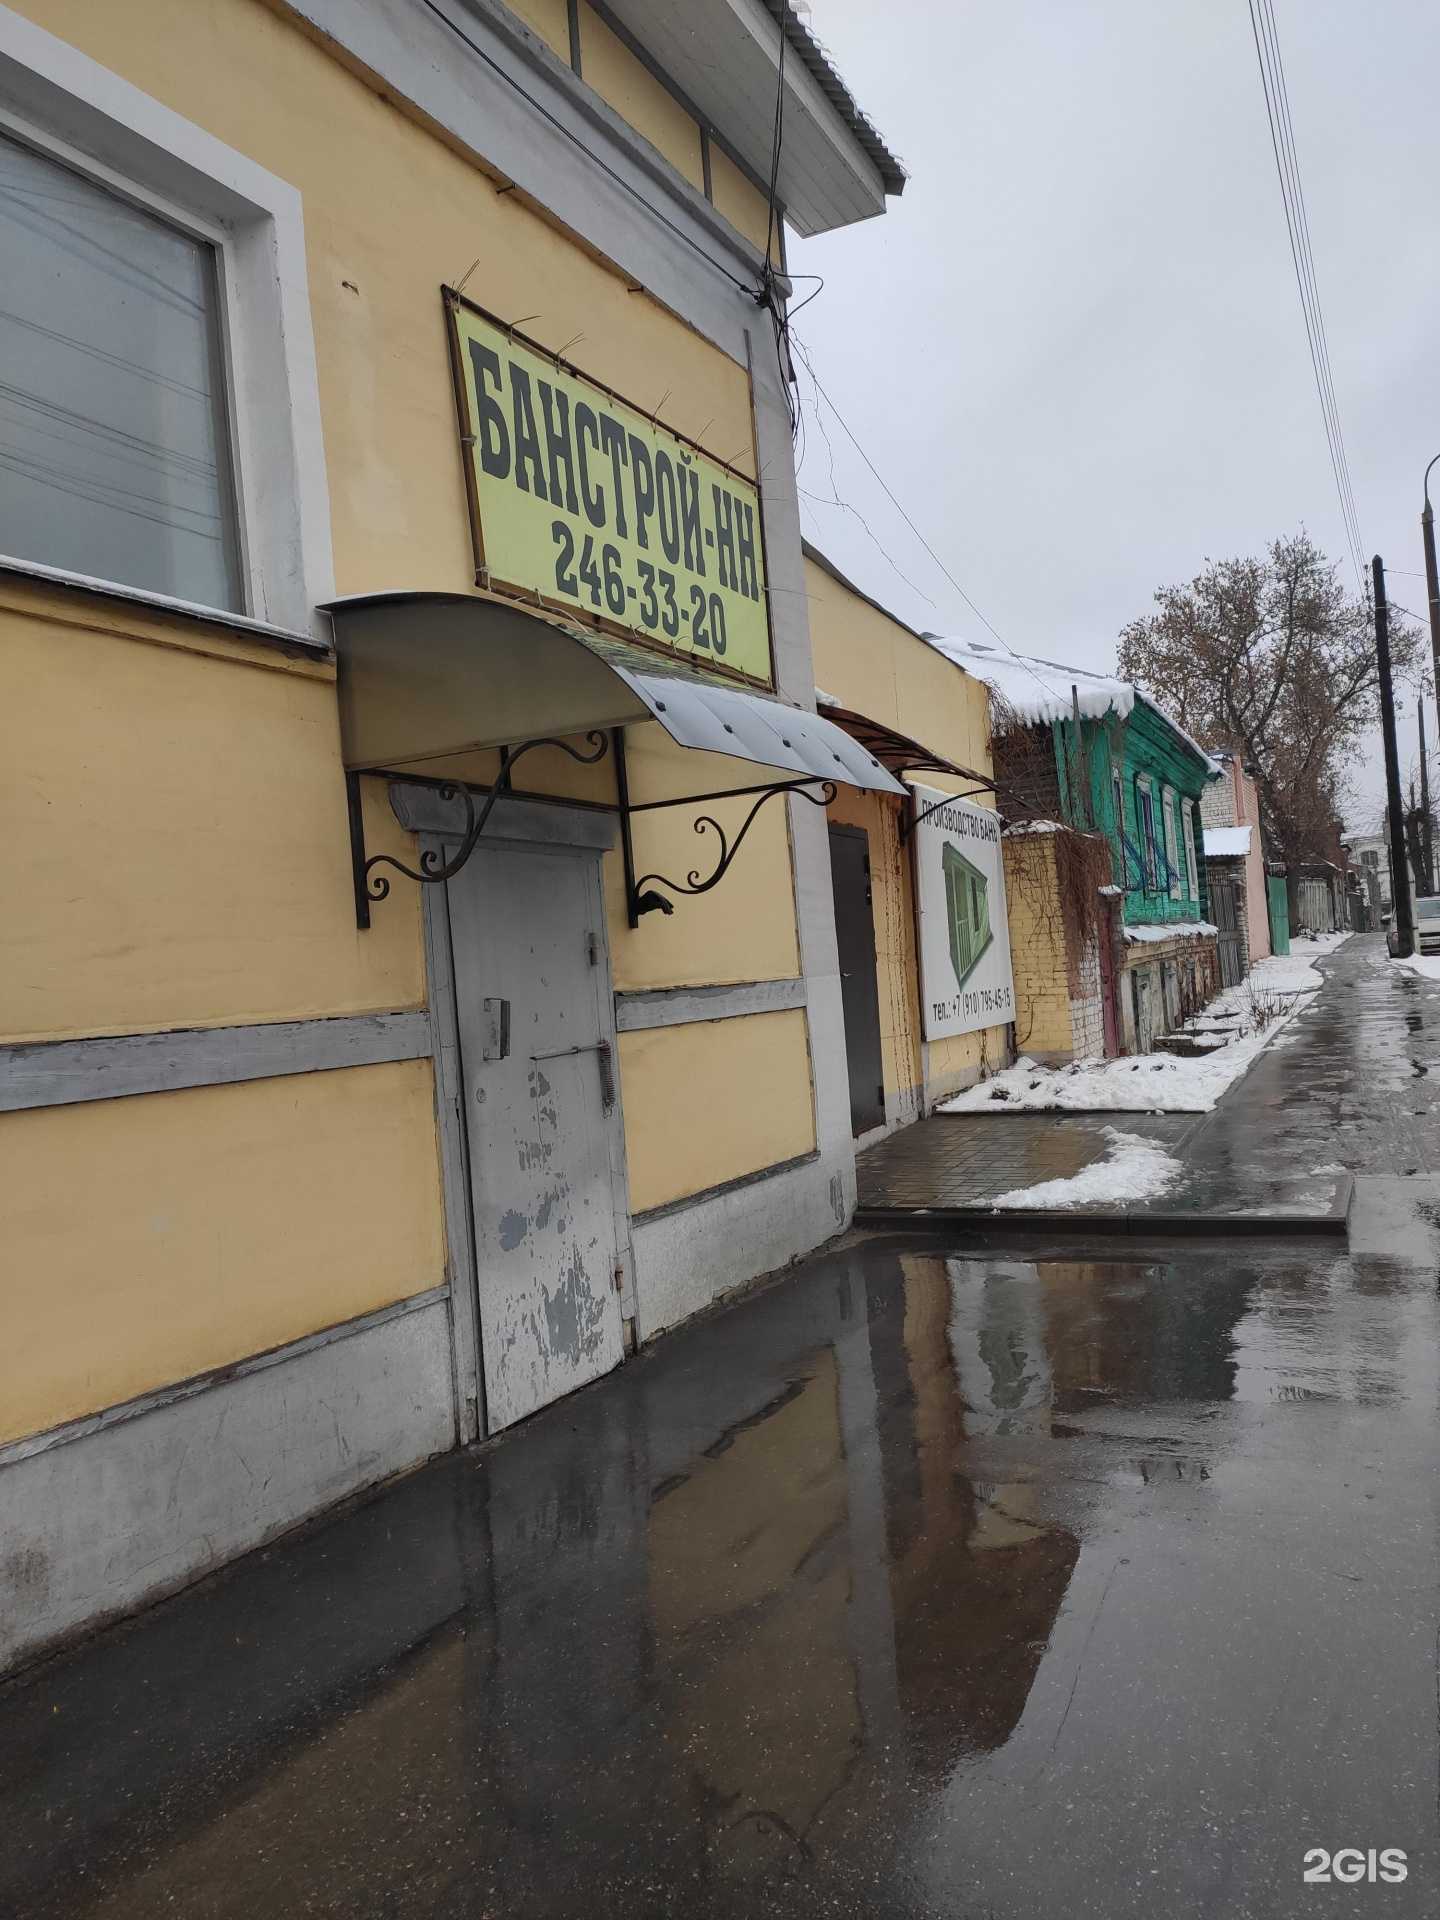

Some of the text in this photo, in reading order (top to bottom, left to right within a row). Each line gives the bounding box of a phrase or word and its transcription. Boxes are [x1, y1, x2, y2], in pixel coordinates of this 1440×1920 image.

[468, 336, 759, 602] БАНСТРОЙ-НН
[551, 520, 727, 656] 246-33-20
[922, 799, 980, 839] ПРОИЗВОДСТВО
[952, 994, 961, 1016] +7
